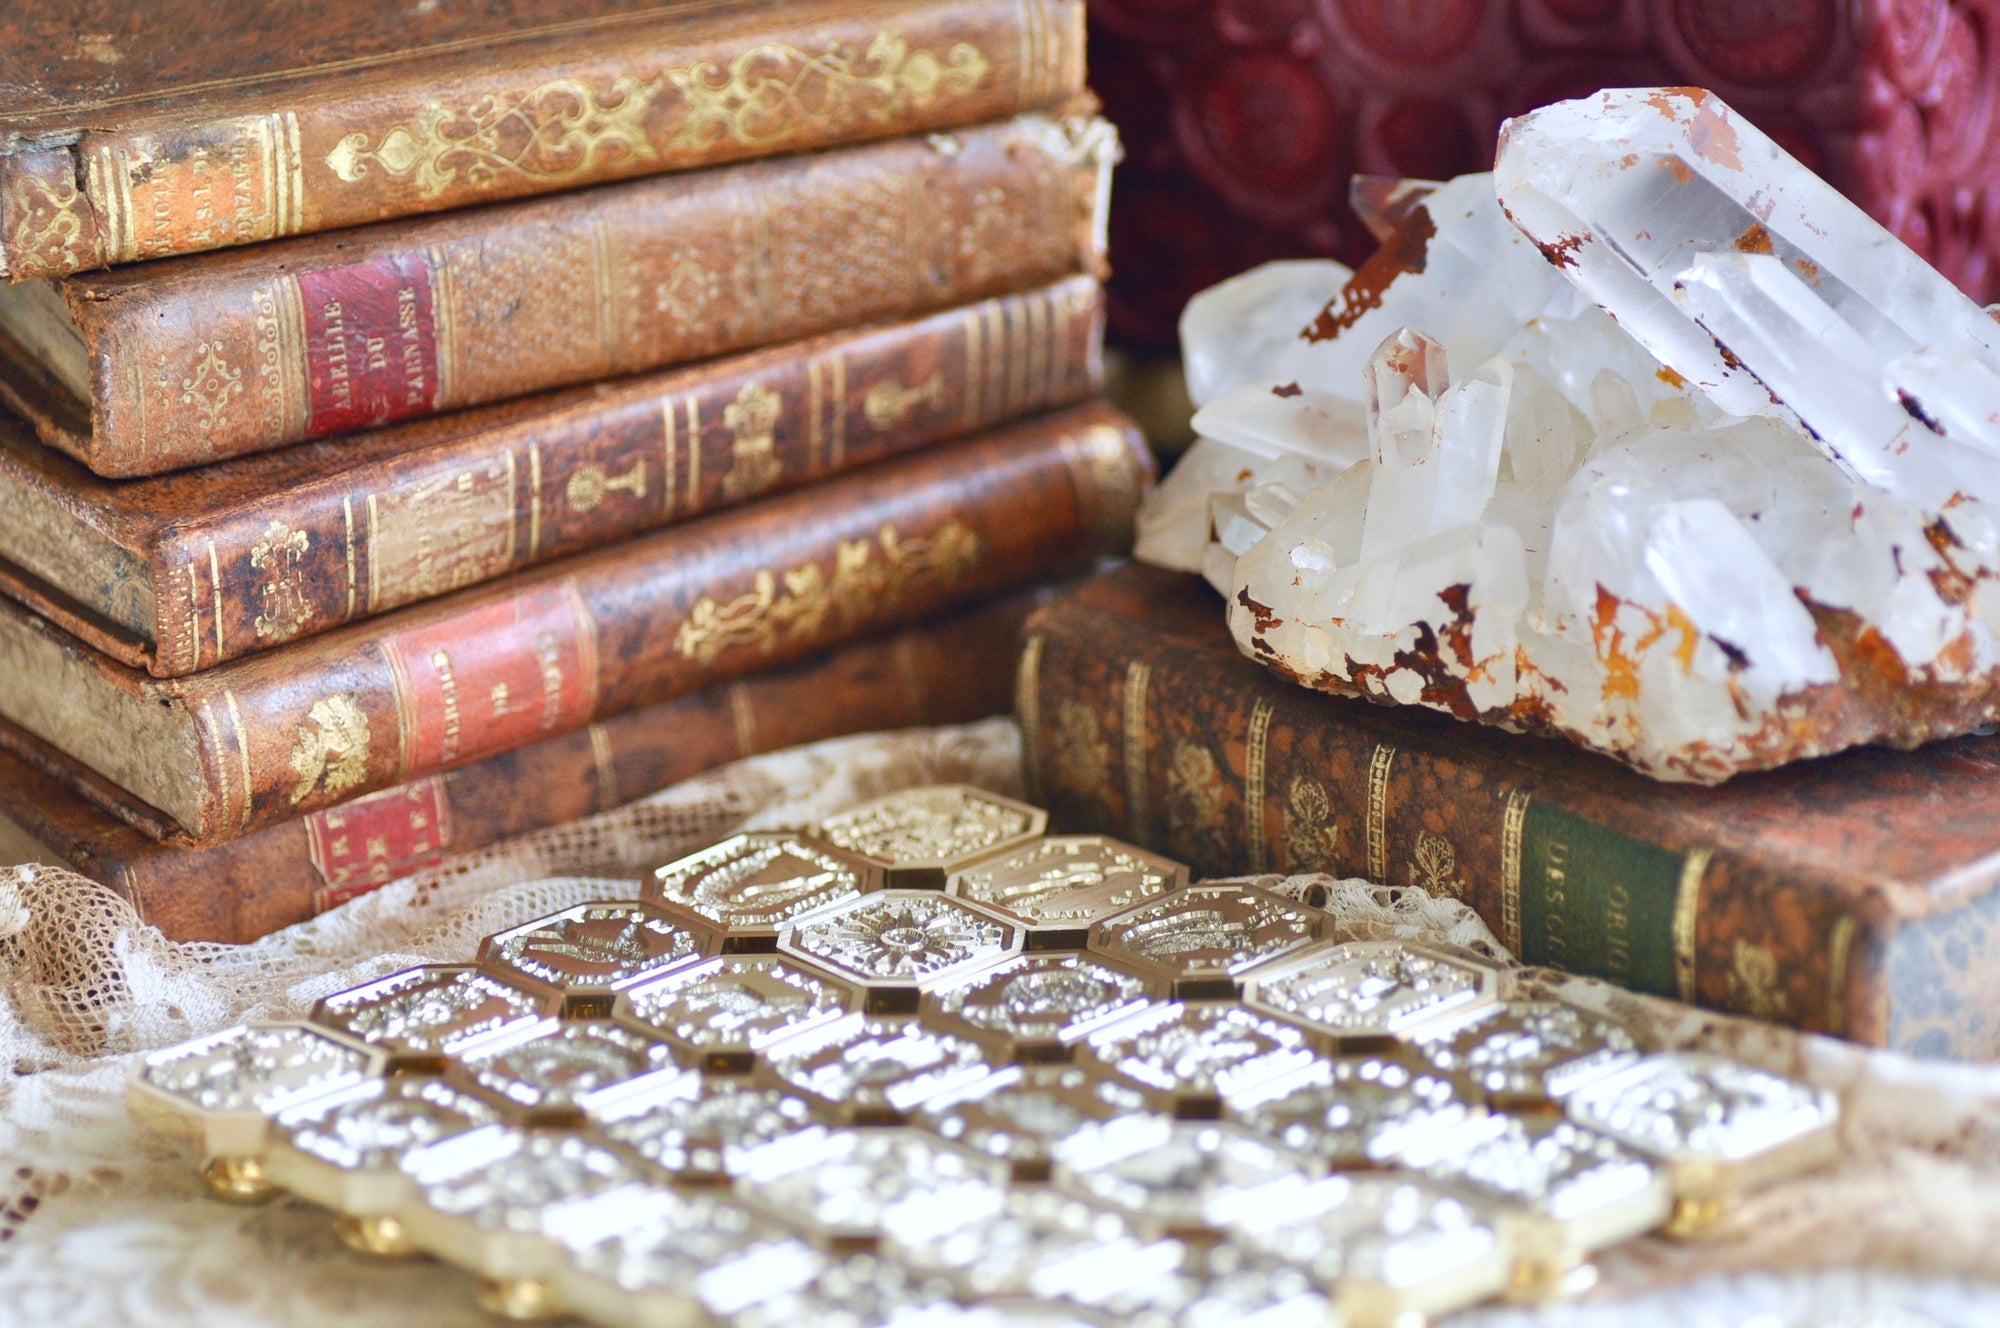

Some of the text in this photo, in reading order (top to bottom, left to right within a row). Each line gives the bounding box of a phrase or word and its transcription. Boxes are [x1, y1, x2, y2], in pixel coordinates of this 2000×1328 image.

[231, 130, 253, 241] ONZAGU
[324, 301, 351, 409] ABEILLE
[367, 336, 386, 371] DU
[399, 286, 425, 405] PARNASSE
[1607, 884, 1630, 983] ORIG
